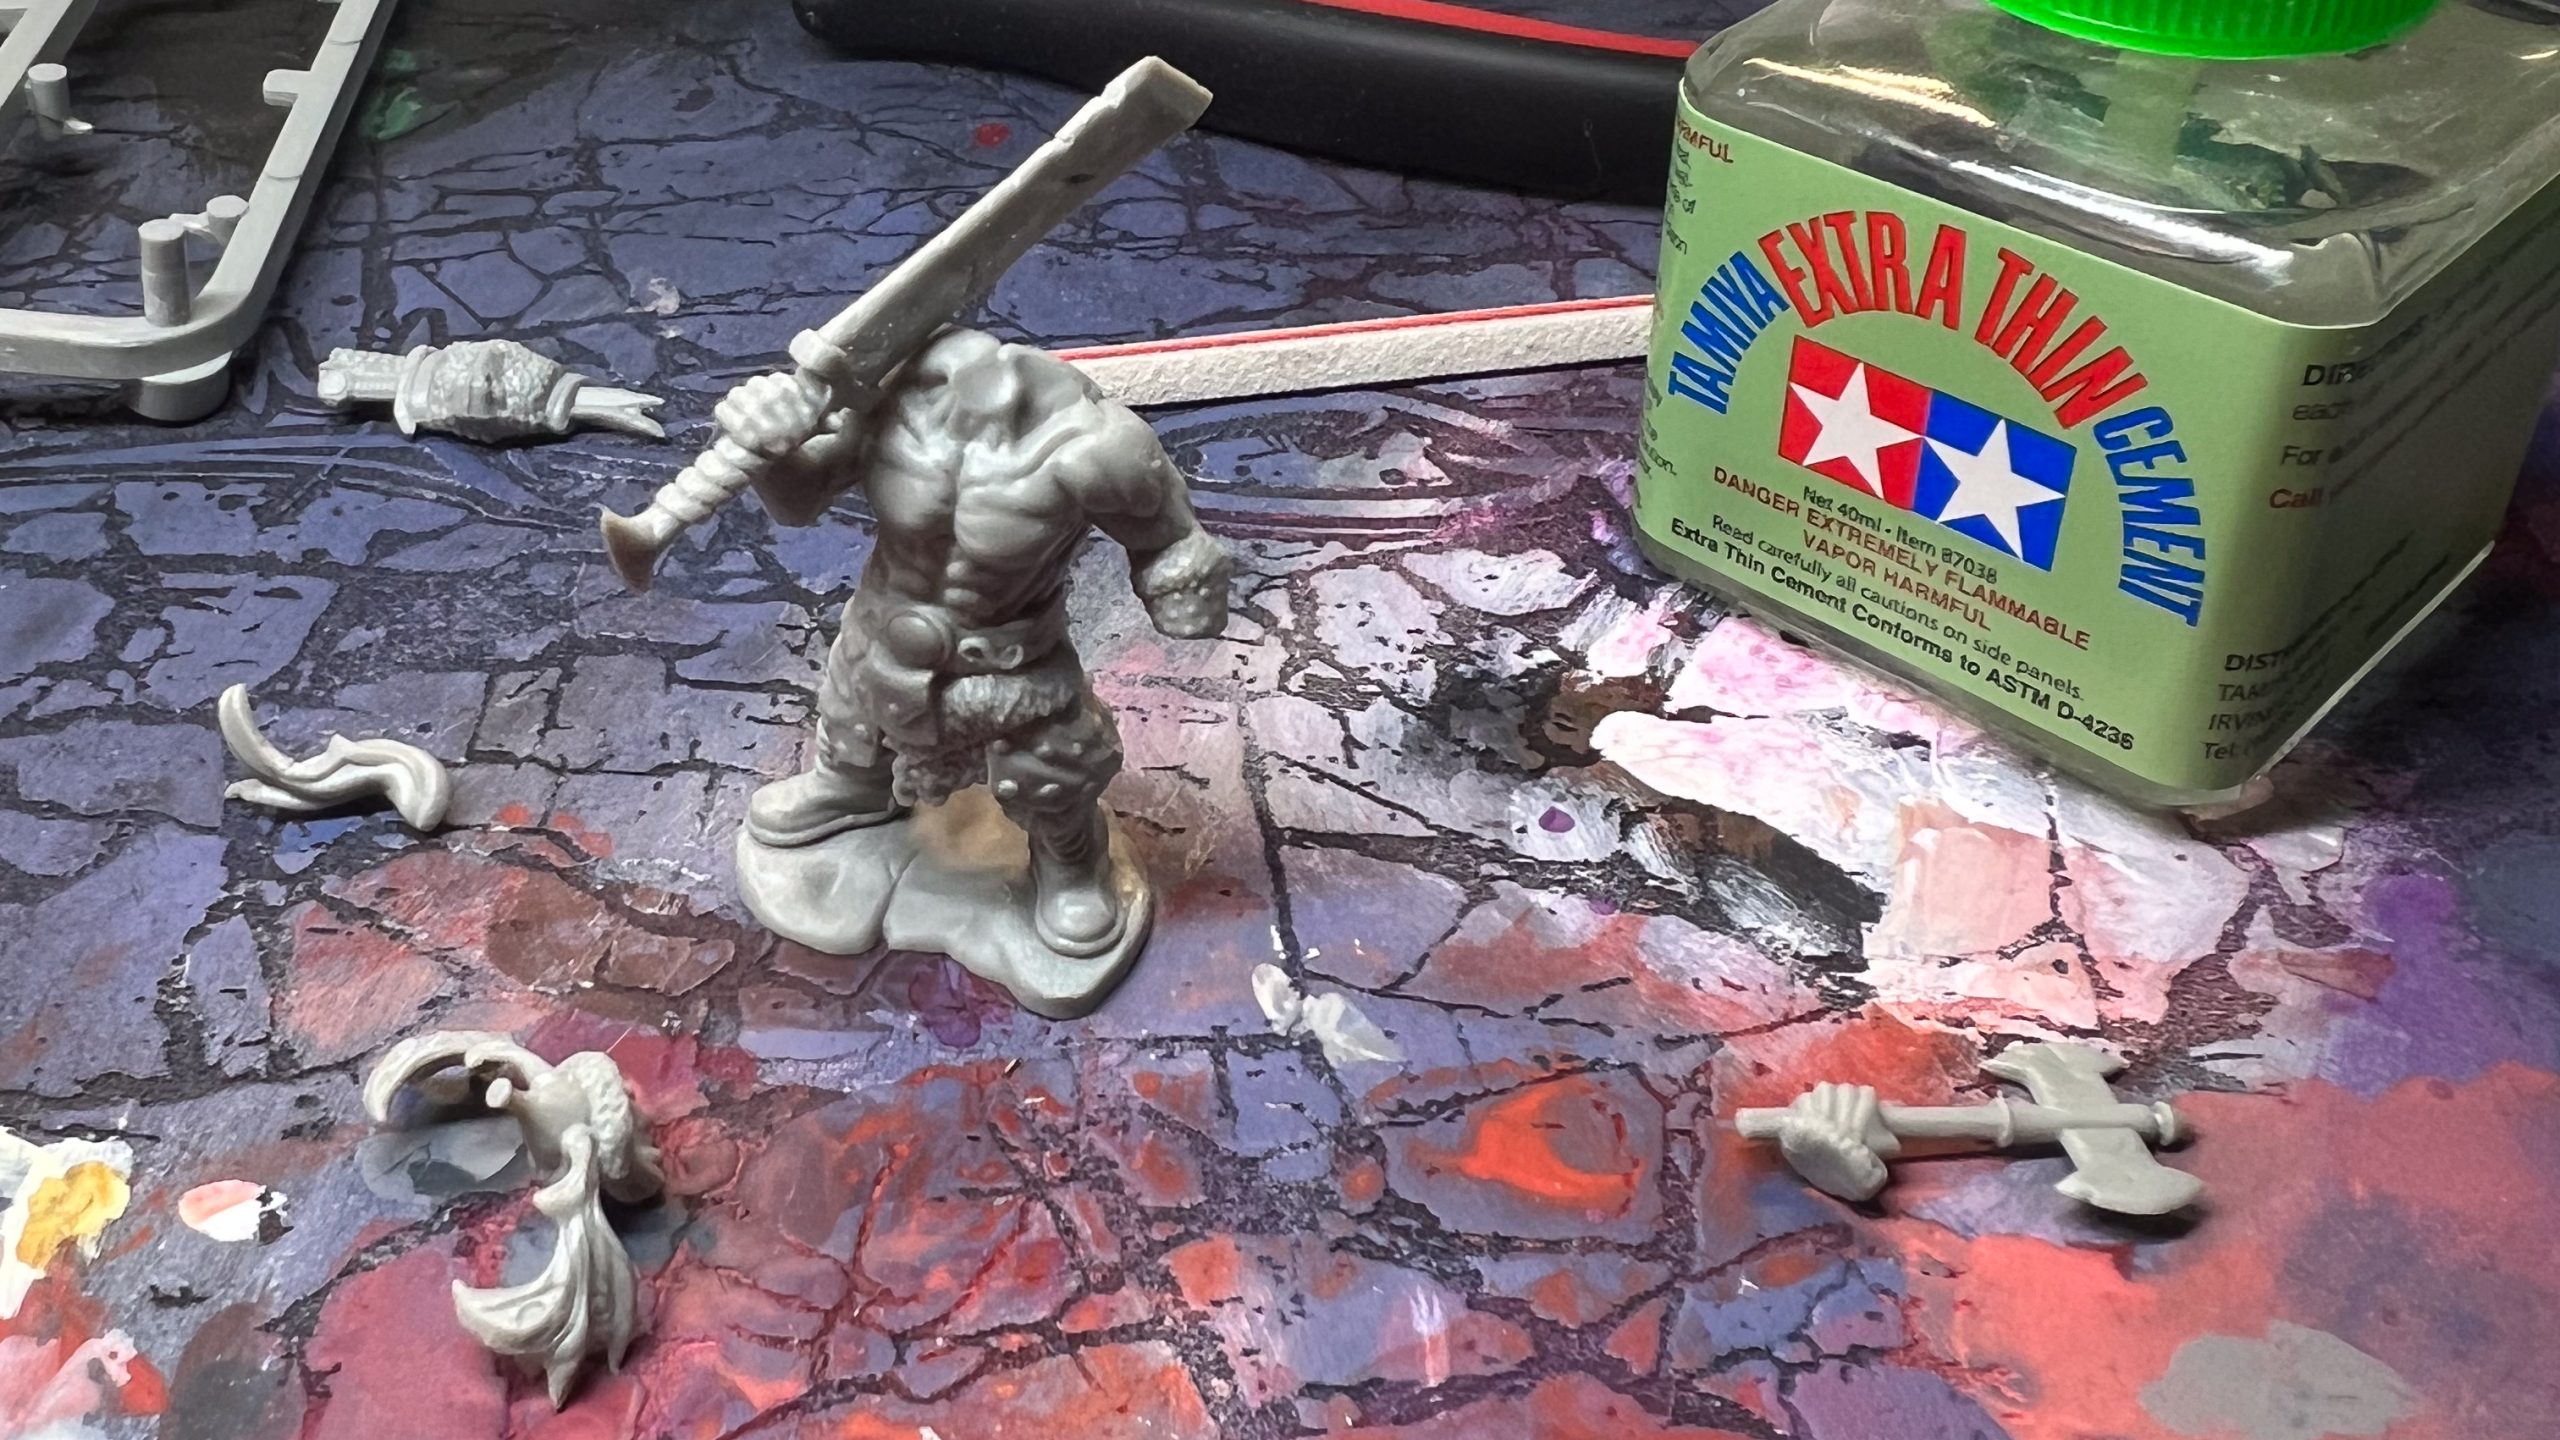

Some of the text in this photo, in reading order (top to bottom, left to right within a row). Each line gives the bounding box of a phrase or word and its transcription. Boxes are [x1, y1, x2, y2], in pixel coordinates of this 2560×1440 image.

[1667, 250, 1790, 415] TAMIYA
[1757, 210, 1967, 329] EXTRA
[1974, 246, 2148, 430] THIN
[2092, 405, 2207, 628] CEMENT
[1671, 517, 1719, 553] Extra
[1724, 541, 1765, 576] Thin
[1770, 566, 1848, 614] Cement
[1852, 603, 1953, 664] Conforms
[1960, 655, 1981, 677] to
[1986, 668, 2051, 711] ASTM
[1713, 466, 2092, 651] DANGER EXTREMELY FLAMMABLE
[1713, 515, 2085, 702] Read carefully all cautions on side panels.
[1802, 529, 1992, 632] VAPOR HARMFUL
[1803, 486, 1833, 512] Net
[1896, 526, 1936, 557] Item
[1942, 548, 1998, 584] 87038
